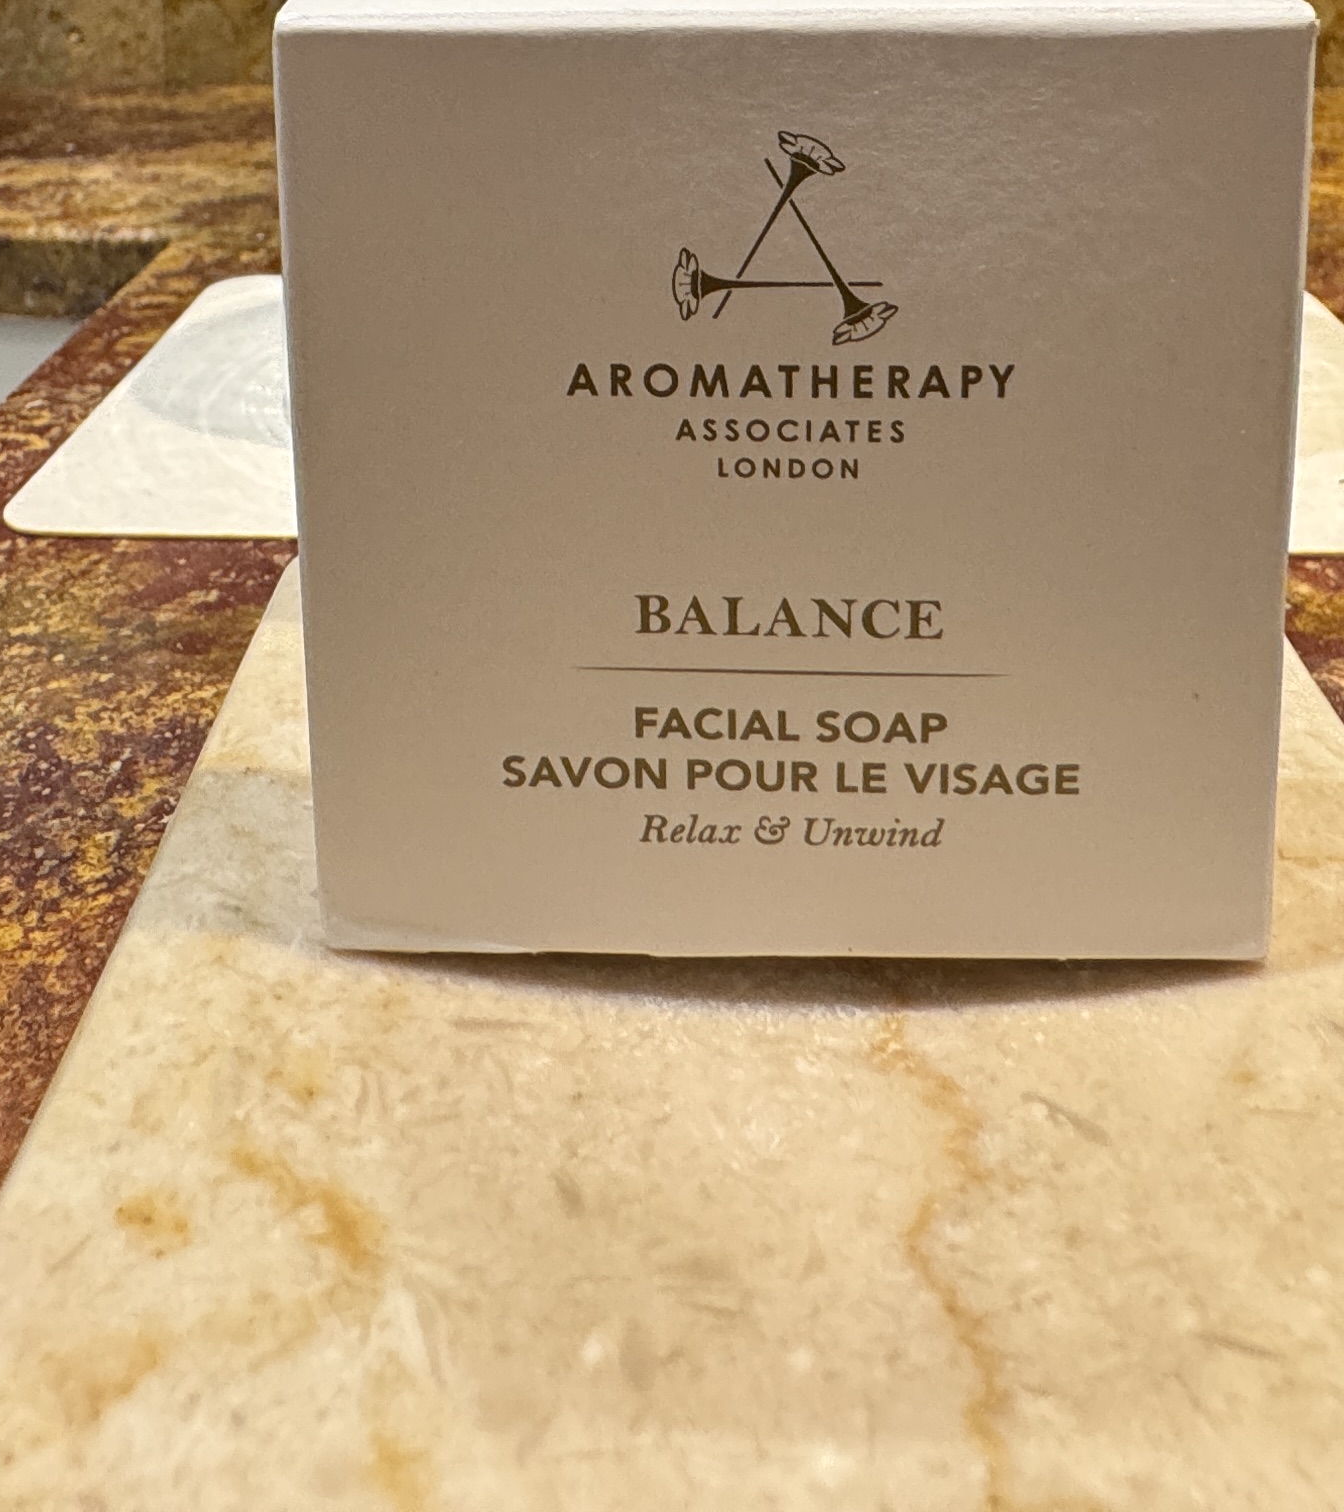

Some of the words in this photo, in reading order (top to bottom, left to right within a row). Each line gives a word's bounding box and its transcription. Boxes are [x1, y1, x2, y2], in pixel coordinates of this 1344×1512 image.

[566, 363, 1016, 399] AROMATHERAPY
[675, 419, 907, 443] ASSOCIATES
[717, 457, 860, 480] LONDON
[635, 593, 945, 639] BALANCE
[634, 706, 801, 742] FACIAL
[815, 709, 949, 744] SOAP
[501, 755, 668, 789] SAVON
[686, 758, 818, 792] POUR
[837, 762, 887, 794] LE
[904, 763, 1081, 796] VISAGE
[639, 813, 742, 846] Relax
[754, 815, 791, 845] &
[803, 817, 945, 849] Unwind
